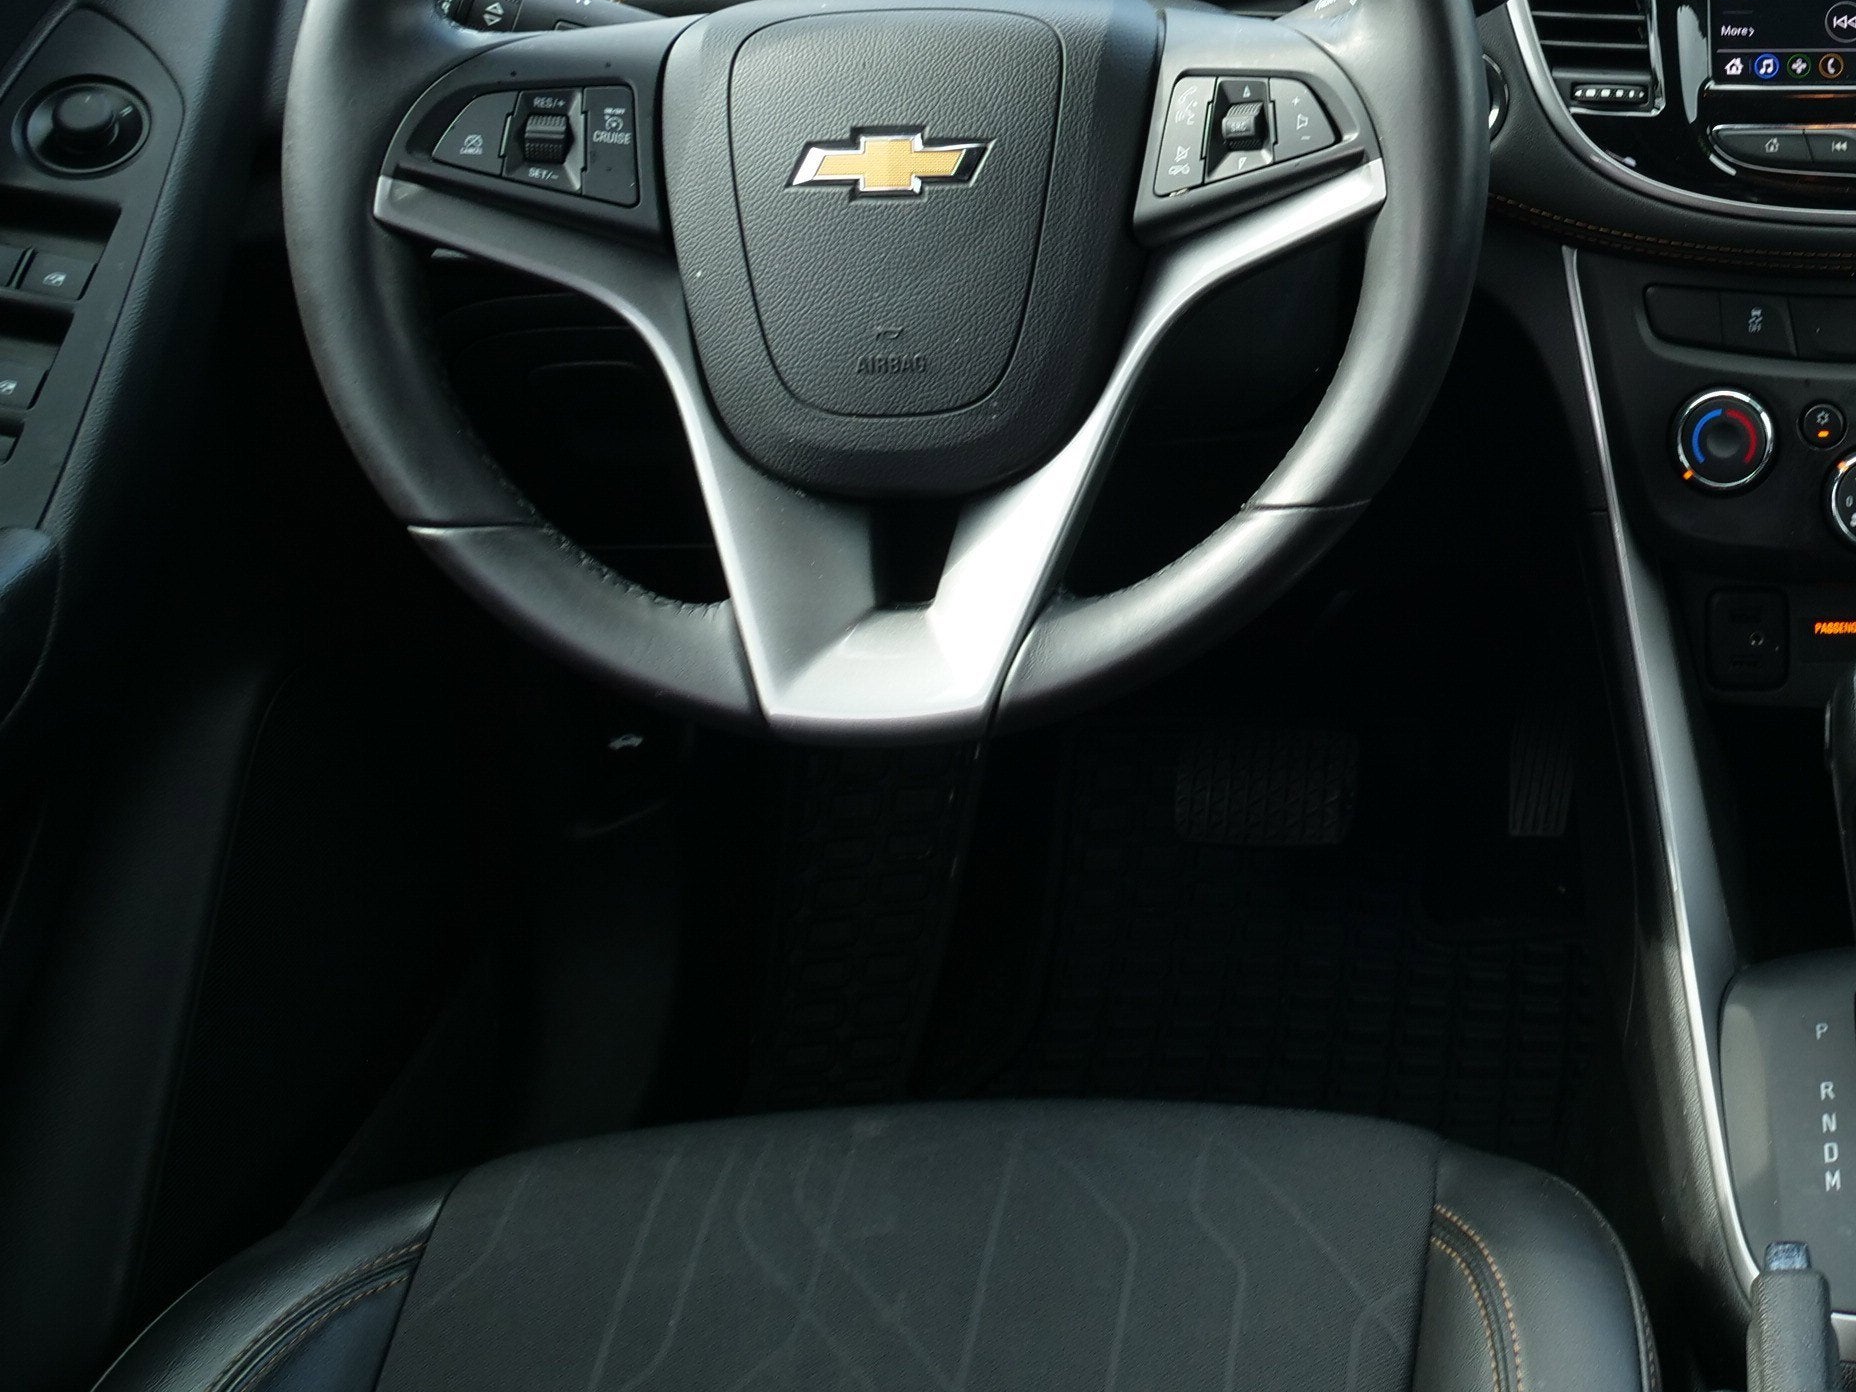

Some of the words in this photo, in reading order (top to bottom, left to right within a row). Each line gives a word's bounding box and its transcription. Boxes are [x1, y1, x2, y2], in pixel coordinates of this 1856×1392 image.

[1721, 24, 1748, 37] More
[533, 96, 566, 108] RES/+
[593, 130, 631, 145] CRUISE
[460, 146, 484, 156] CANCEL
[856, 354, 928, 374] AIRBAG
[1815, 1022, 1828, 1041] P
[1820, 1081, 1836, 1101] R
[1821, 1112, 1837, 1133] N
[1823, 1141, 1839, 1163] D
[1825, 1168, 1842, 1192] M
